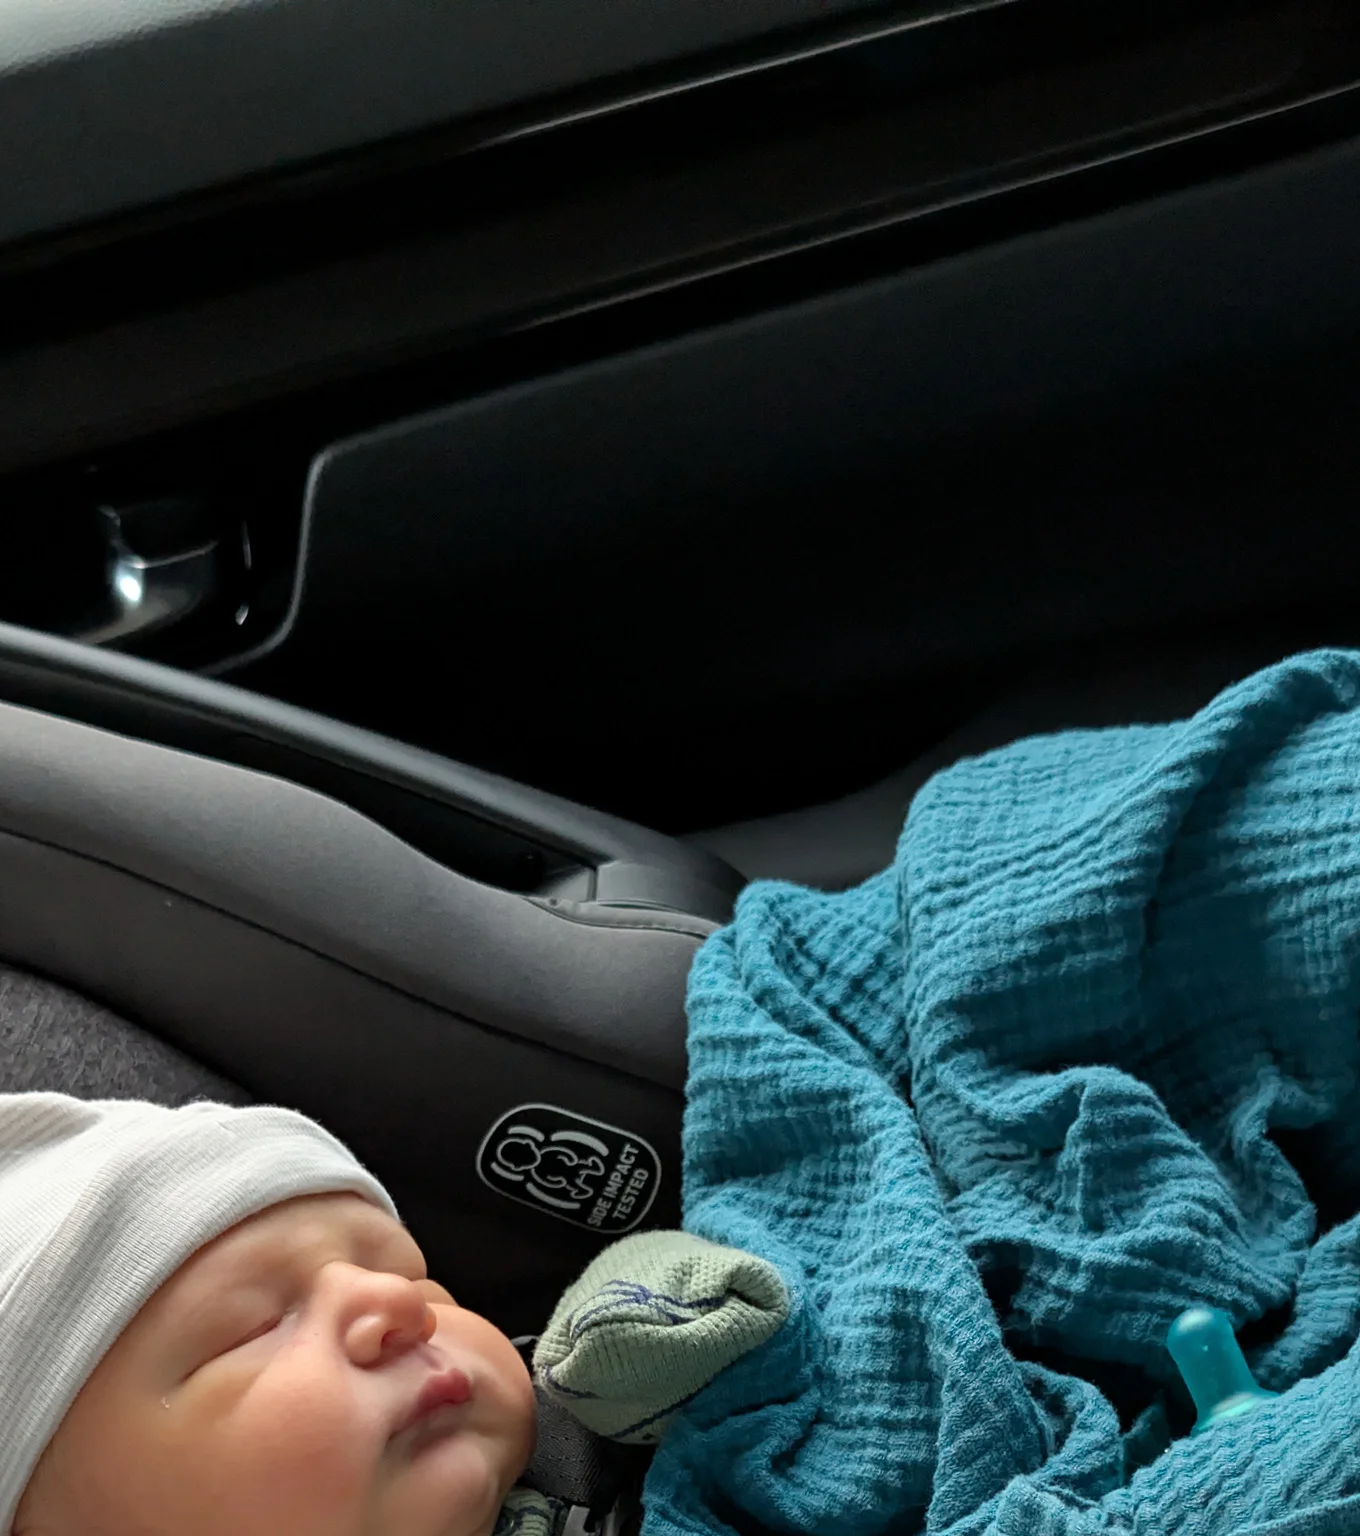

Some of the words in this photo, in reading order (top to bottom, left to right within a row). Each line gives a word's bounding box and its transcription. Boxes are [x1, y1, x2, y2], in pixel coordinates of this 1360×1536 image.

[587, 1198, 612, 1226] SIDE
[603, 1144, 639, 1198] IMPACT
[612, 1168, 648, 1219] TESTED
